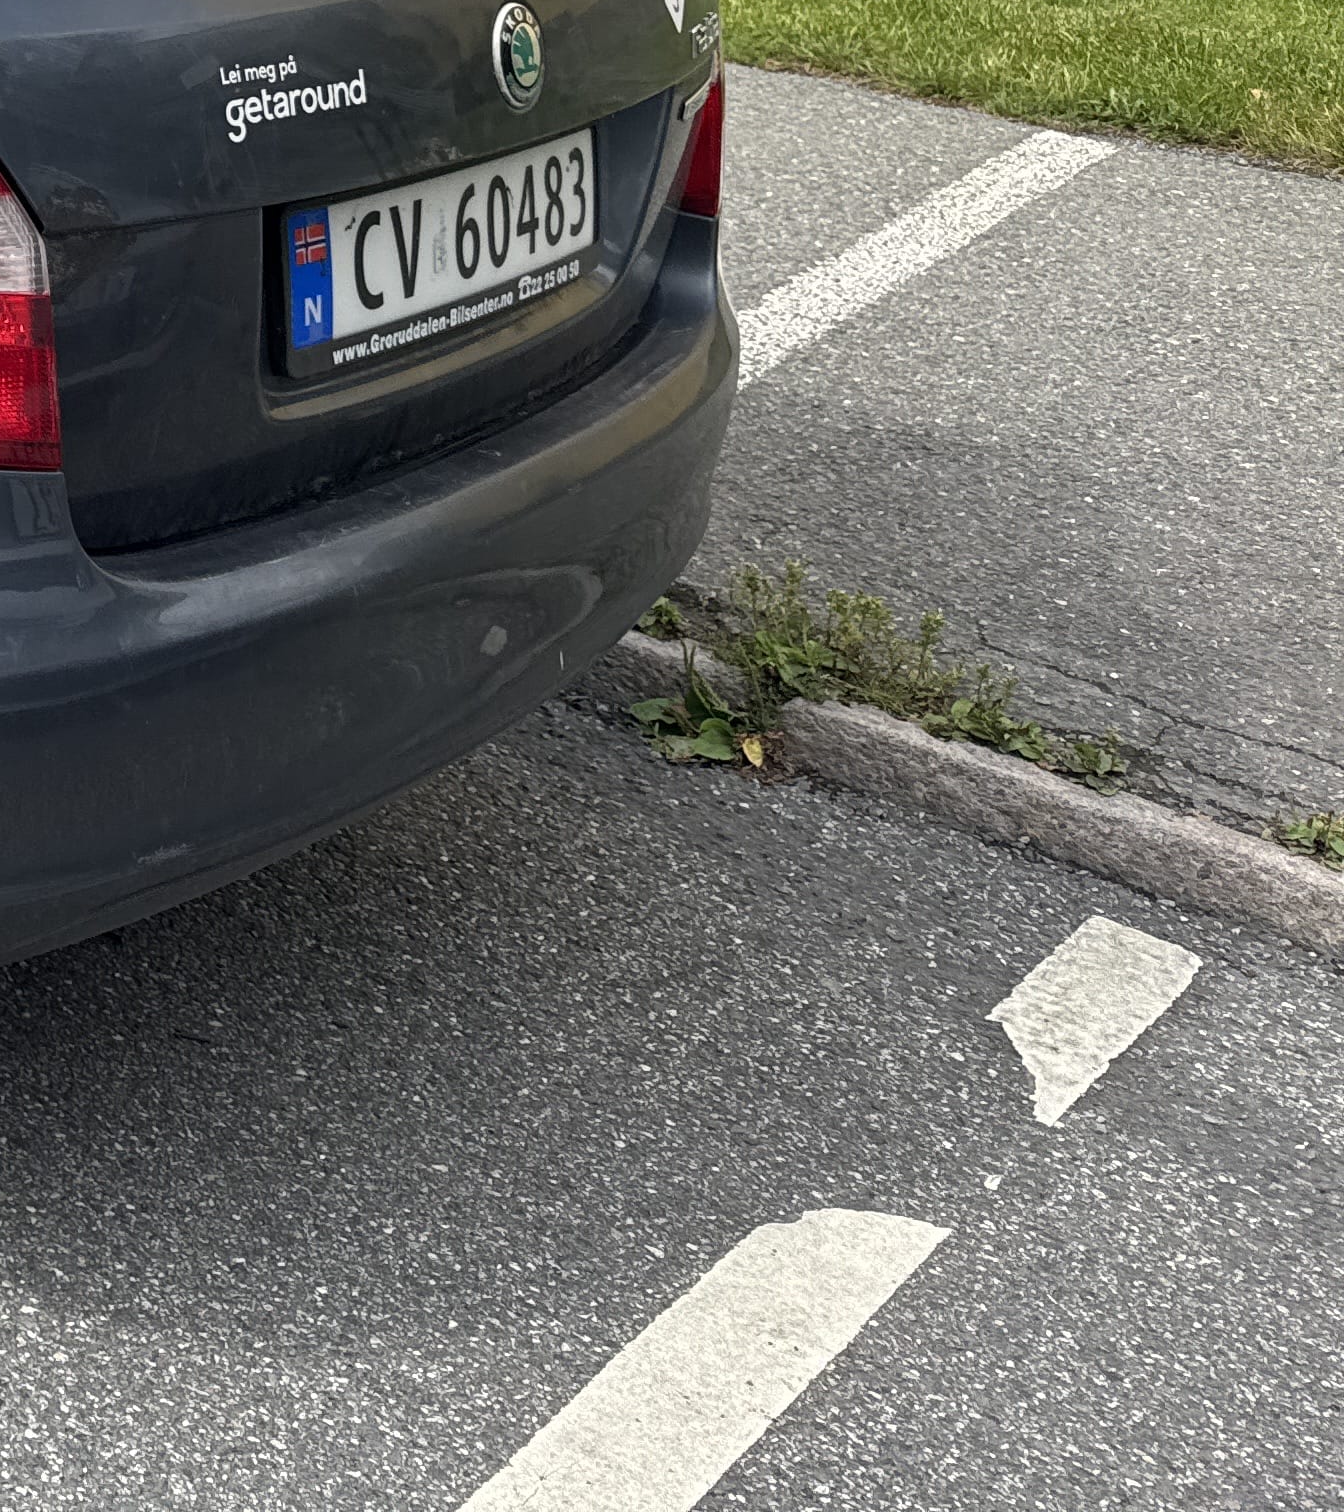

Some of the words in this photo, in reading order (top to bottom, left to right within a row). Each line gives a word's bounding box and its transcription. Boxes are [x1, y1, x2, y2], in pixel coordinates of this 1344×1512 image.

[220, 63, 242, 85] Lei
[244, 64, 276, 83] meg
[279, 54, 297, 82] på
[225, 68, 367, 143] getaround
[354, 199, 423, 310] CV
[455, 146, 587, 280] 60483
[544, 270, 555, 290] 25
[304, 294, 323, 327] N
